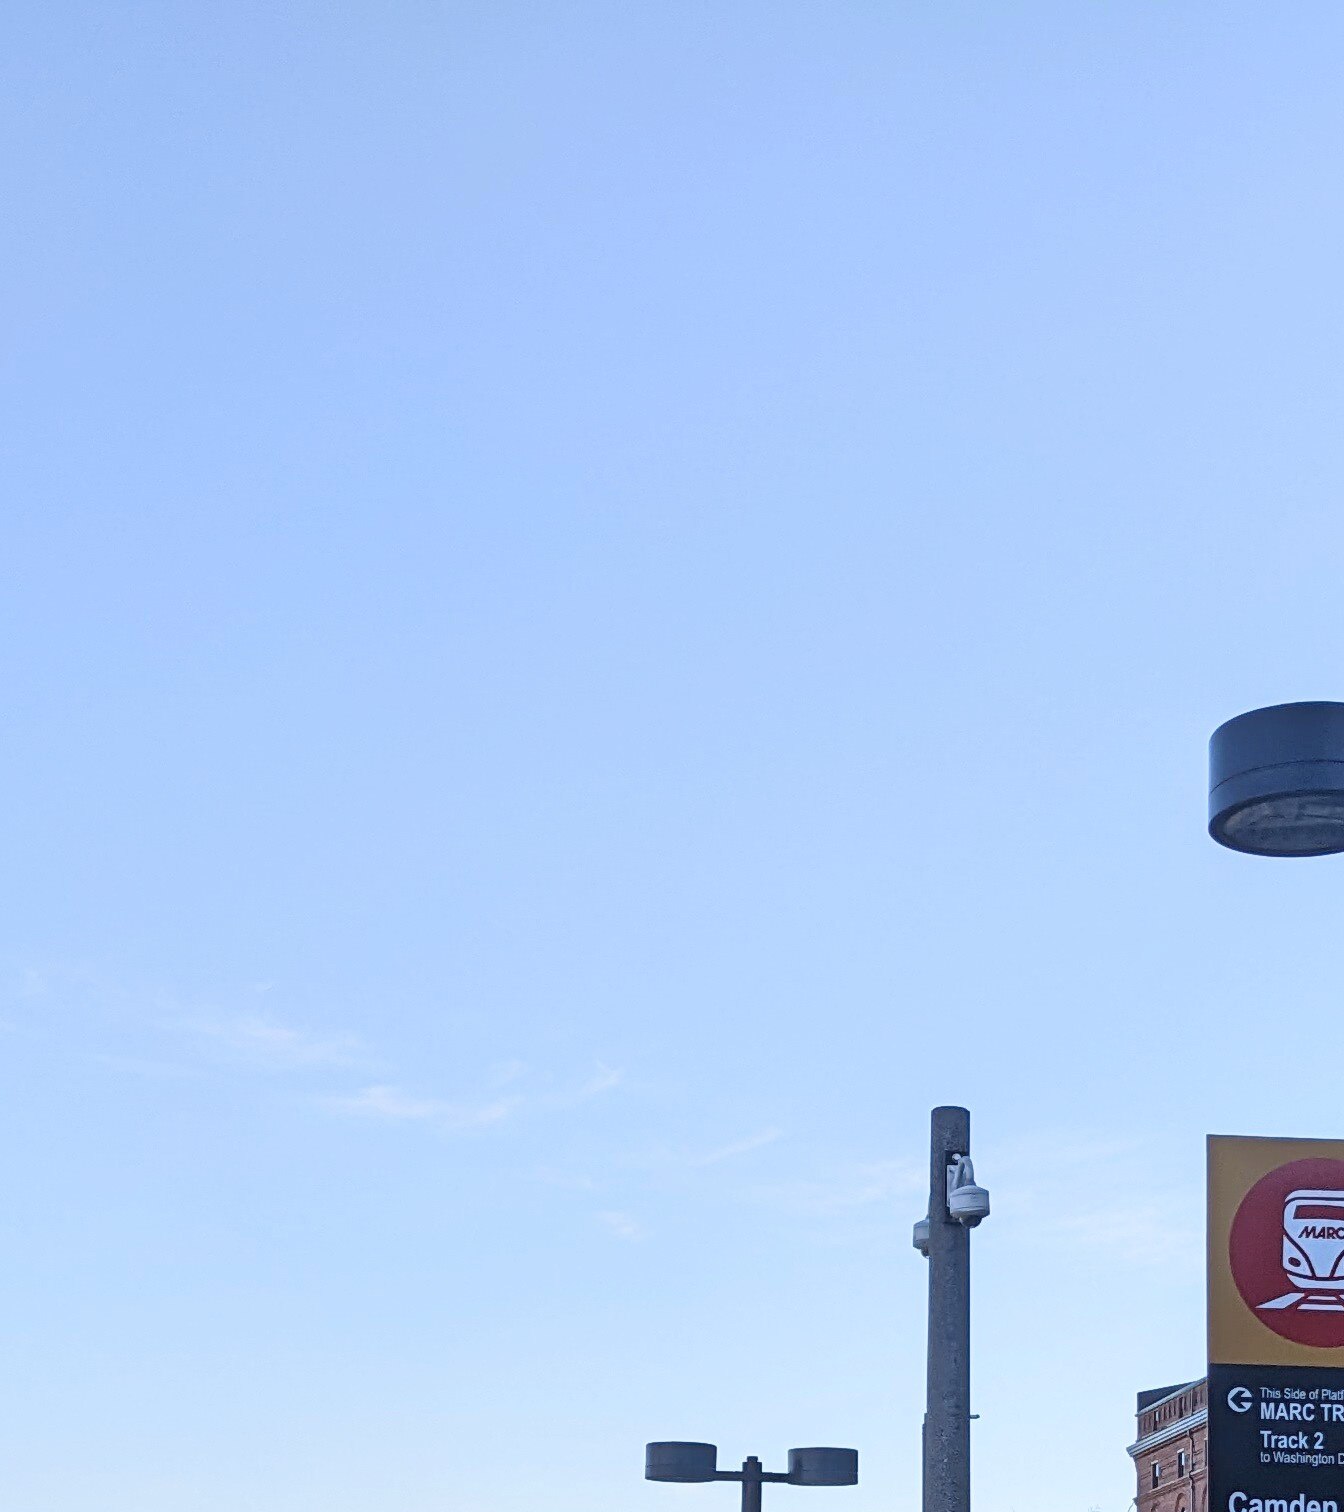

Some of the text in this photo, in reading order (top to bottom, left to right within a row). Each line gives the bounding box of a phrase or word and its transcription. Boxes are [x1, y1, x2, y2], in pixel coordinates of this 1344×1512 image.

[1259, 1387, 1281, 1399] This
[1283, 1388, 1306, 1400] Side
[1308, 1388, 1319, 1400] of
[1260, 1402, 1315, 1421] MARC
[1260, 1430, 1324, 1450] Track 2
[1260, 1452, 1270, 1463] to
[1273, 1452, 1335, 1466] Washington
